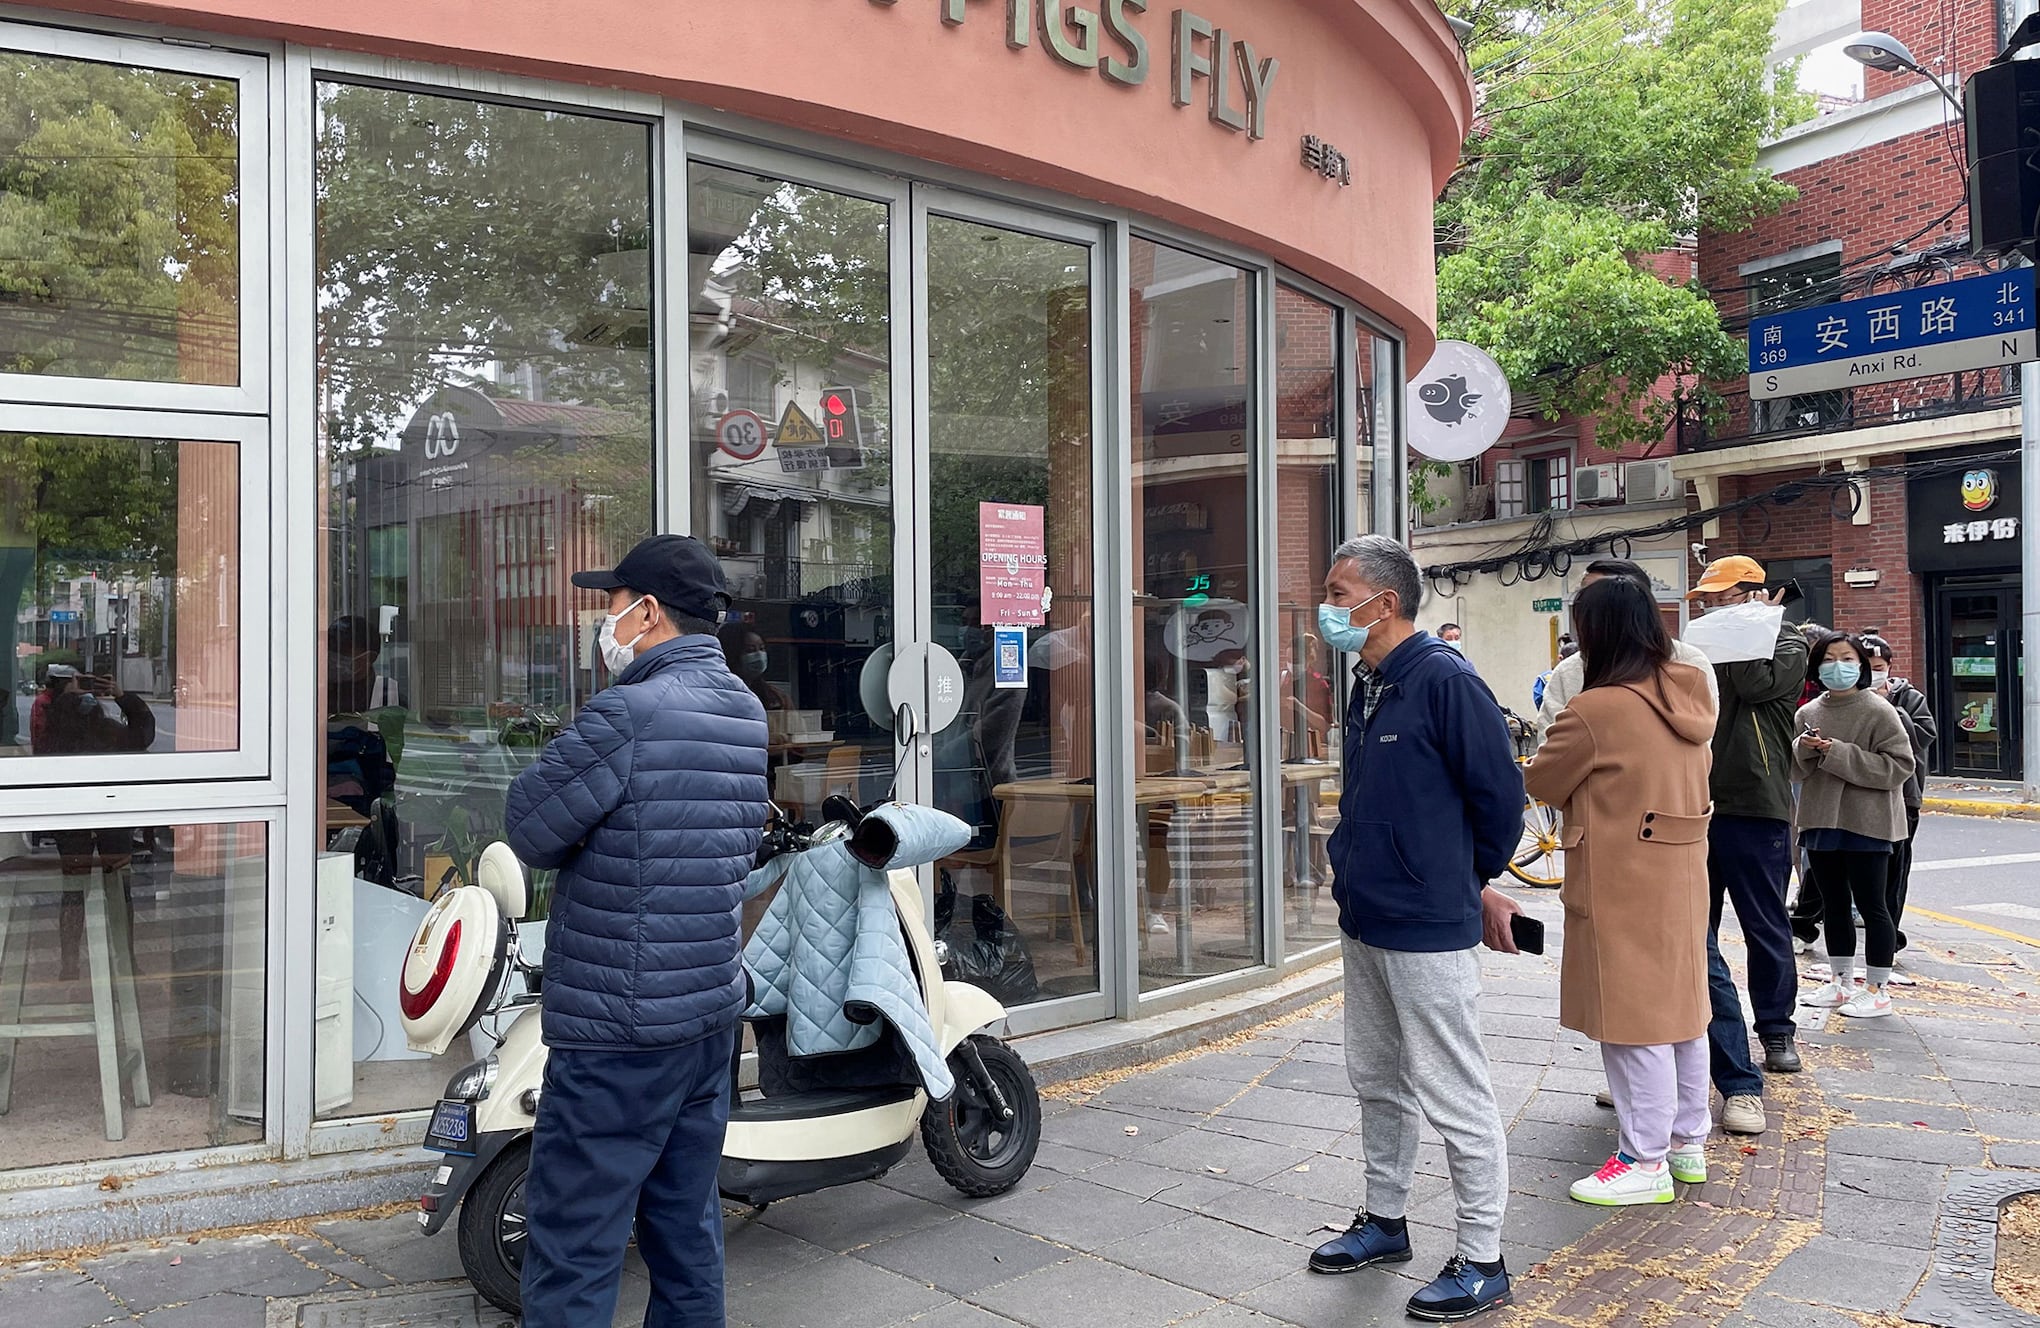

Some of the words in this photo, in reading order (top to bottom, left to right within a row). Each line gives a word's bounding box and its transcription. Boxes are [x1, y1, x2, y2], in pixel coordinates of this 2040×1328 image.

[941, 0, 1150, 87] IGS
[1171, 8, 1280, 141] FLY
[1996, 281, 2021, 305] 北
[1815, 295, 1958, 354] 安西路
[1993, 308, 2025, 327] 341
[1763, 325, 1782, 347] 南
[1759, 348, 1787, 365] 369
[2001, 338, 2018, 358] N
[1849, 358, 1885, 376] Anxi
[1893, 354, 1922, 370] Rd.
[1765, 375, 1778, 392] S
[1943, 518, 2017, 544] 来伊份
[982, 553, 1018, 563] OPENING
[1020, 554, 1048, 565] HOURS
[997, 580, 1013, 588] Mon
[1020, 580, 1033, 588] Thu
[1017, 609, 1031, 617] Sun
[937, 675, 953, 694] 推
